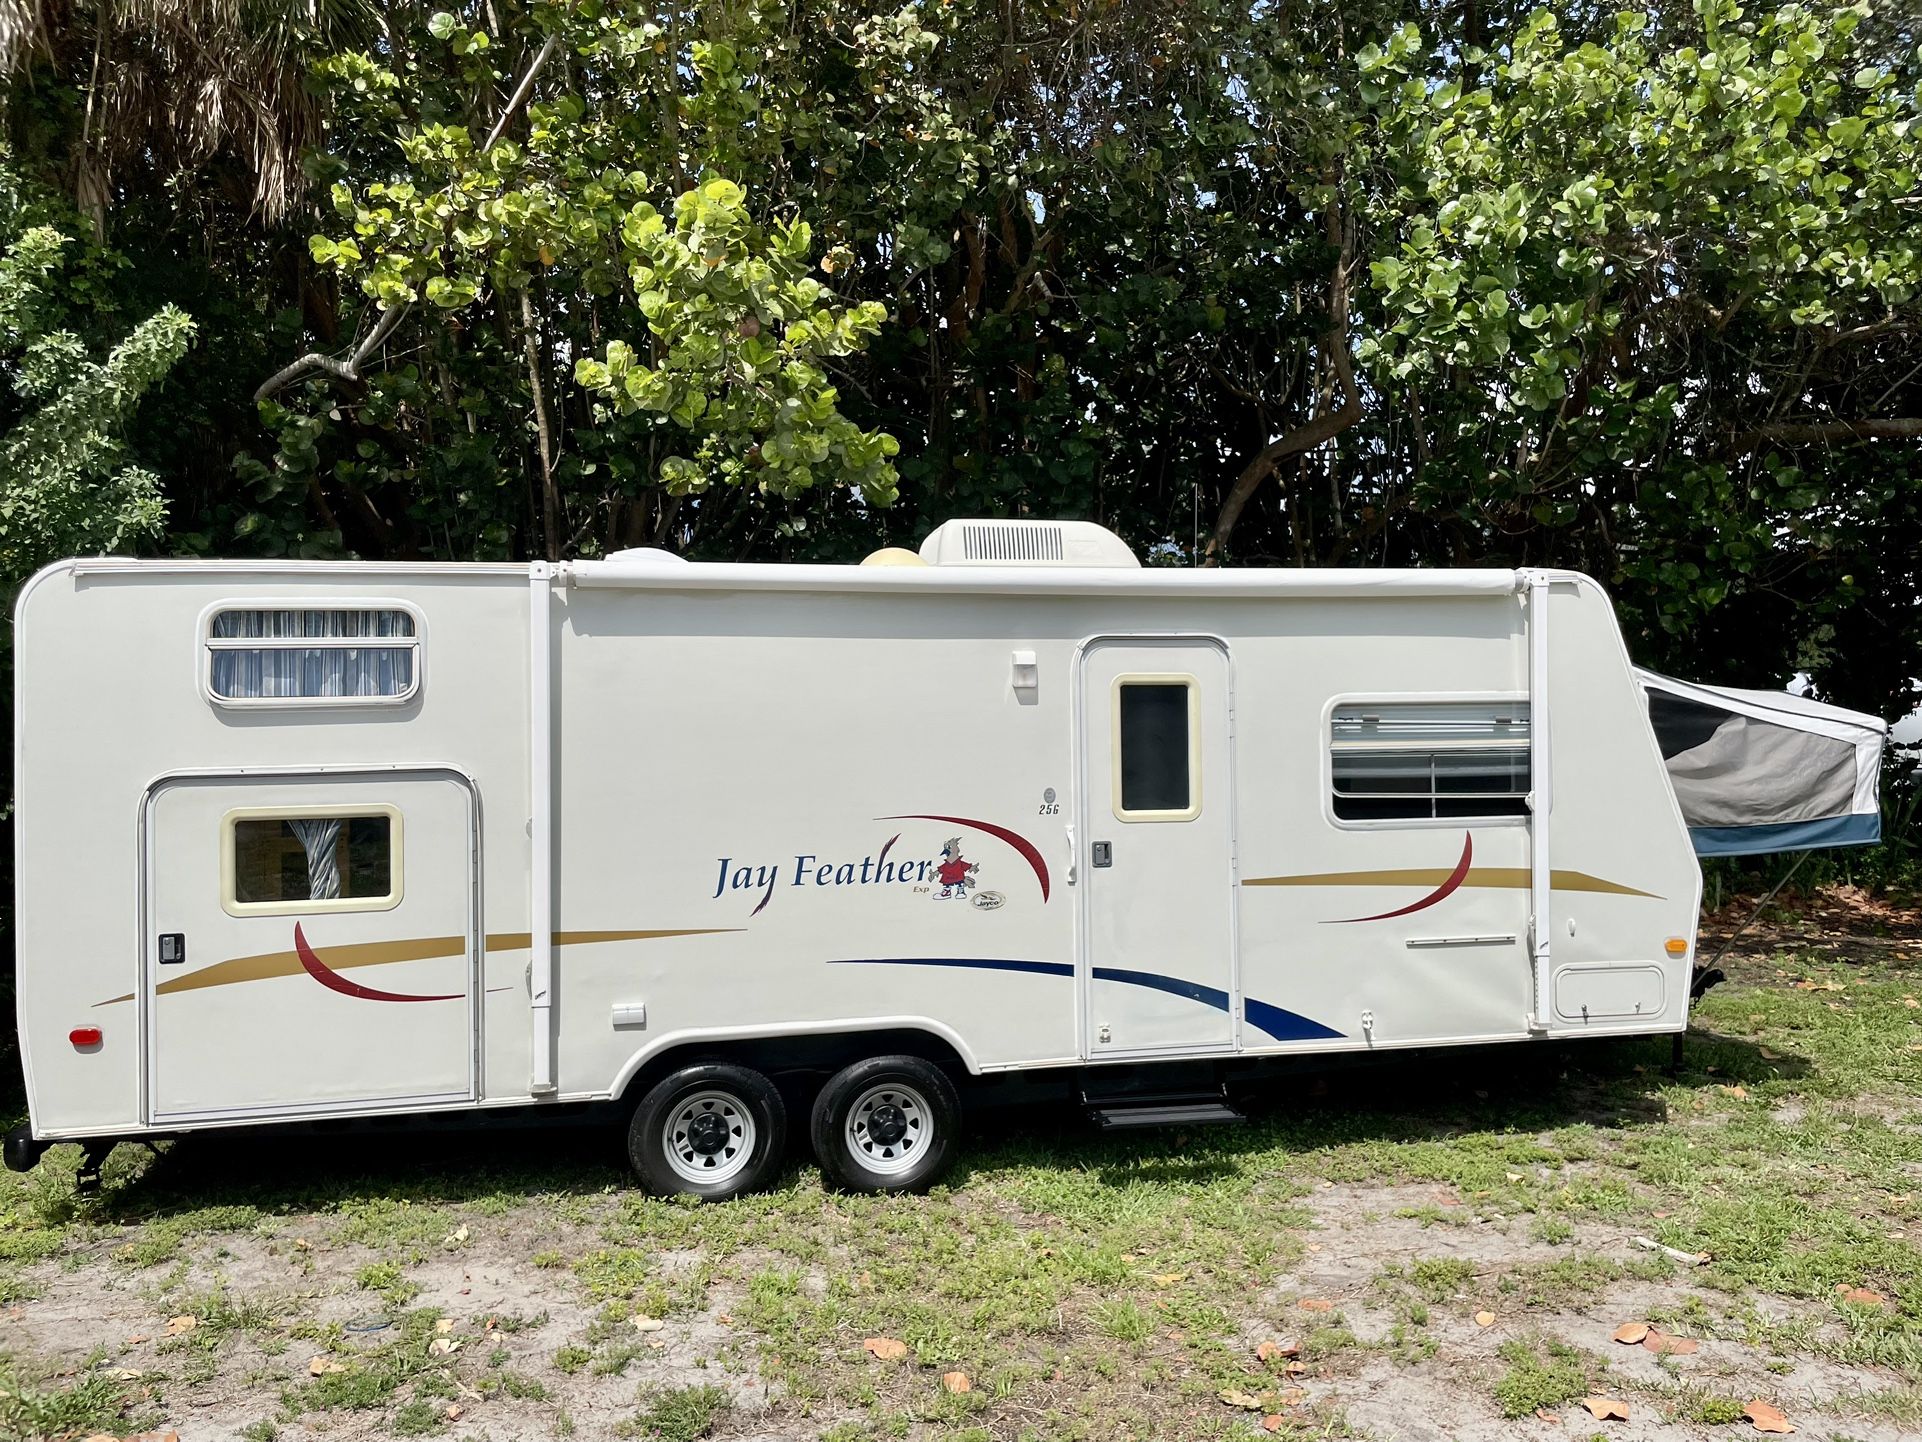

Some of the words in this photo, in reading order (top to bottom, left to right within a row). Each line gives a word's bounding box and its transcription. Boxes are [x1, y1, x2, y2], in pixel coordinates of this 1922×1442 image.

[712, 857, 779, 918] Jay
[791, 832, 933, 887] Feather
[913, 886, 930, 894] Exp
